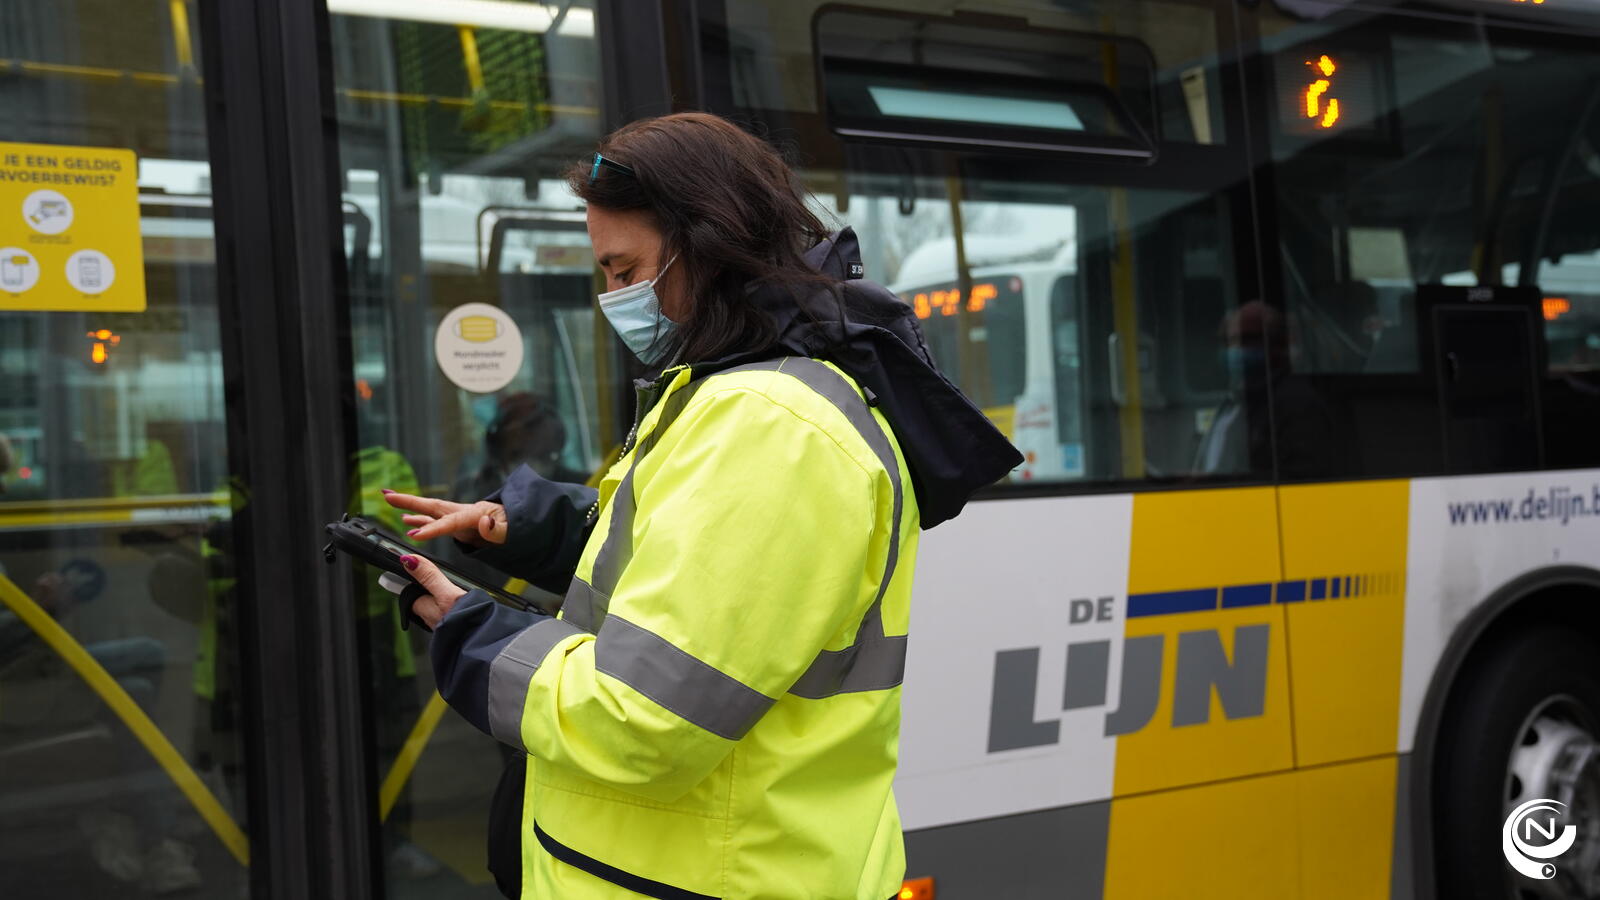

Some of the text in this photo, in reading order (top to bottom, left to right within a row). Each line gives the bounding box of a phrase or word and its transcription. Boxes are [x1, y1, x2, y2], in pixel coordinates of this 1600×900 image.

[4, 154, 122, 172] JE EEN GELDIG
[1069, 596, 1115, 625] DE
[986, 623, 1271, 755] LIJN
